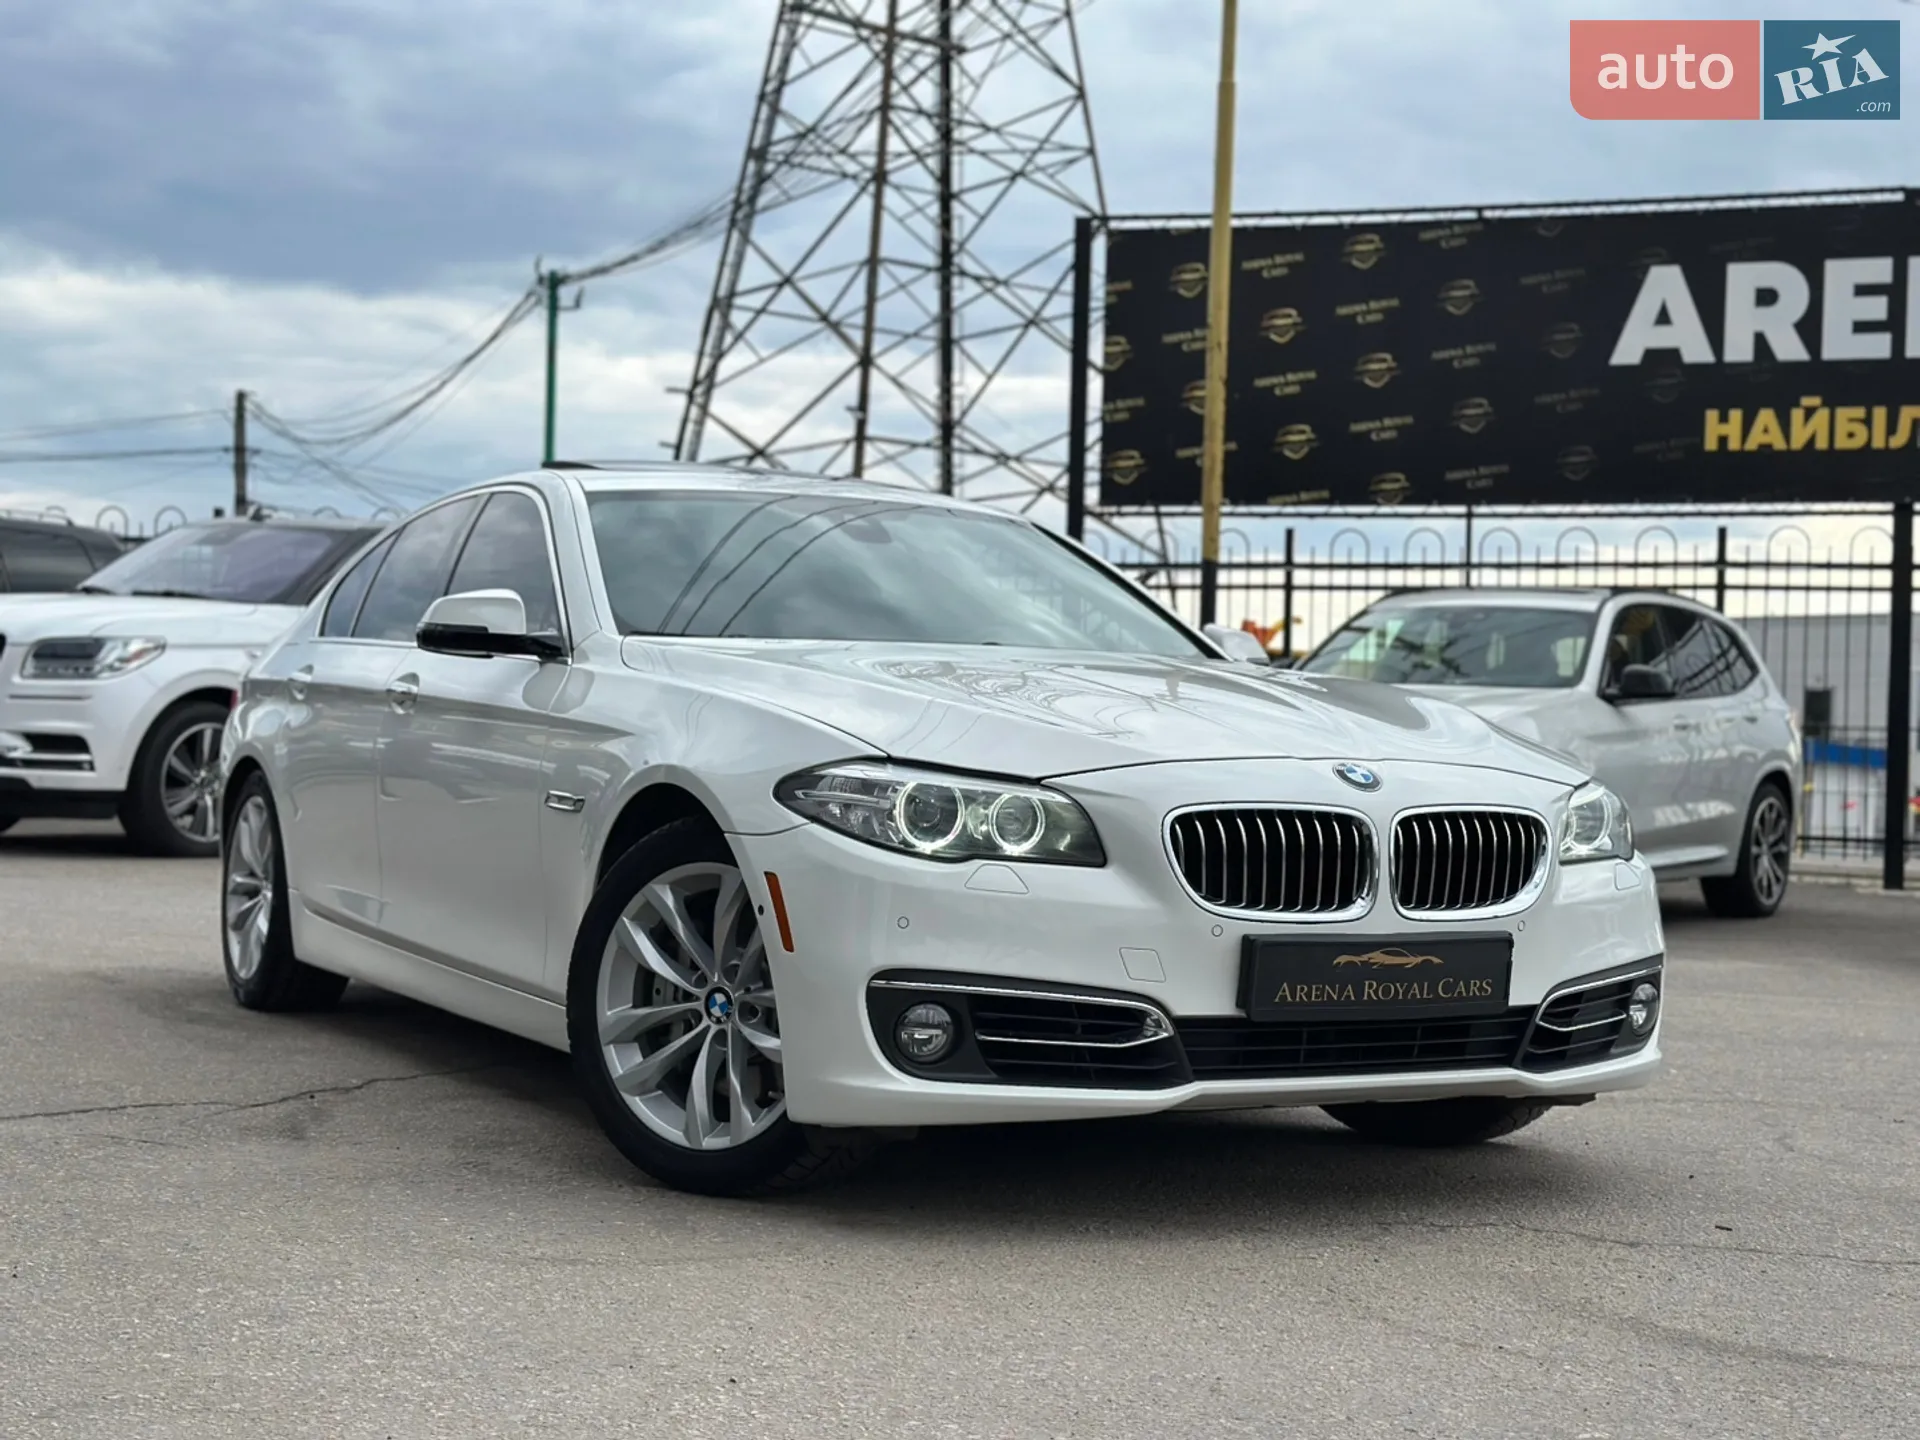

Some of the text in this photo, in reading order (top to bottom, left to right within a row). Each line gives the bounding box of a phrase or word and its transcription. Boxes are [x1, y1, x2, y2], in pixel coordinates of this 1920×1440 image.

[1608, 255, 1920, 367] ARE
[1274, 977, 1493, 1003] ARENA ROYAL CARS
